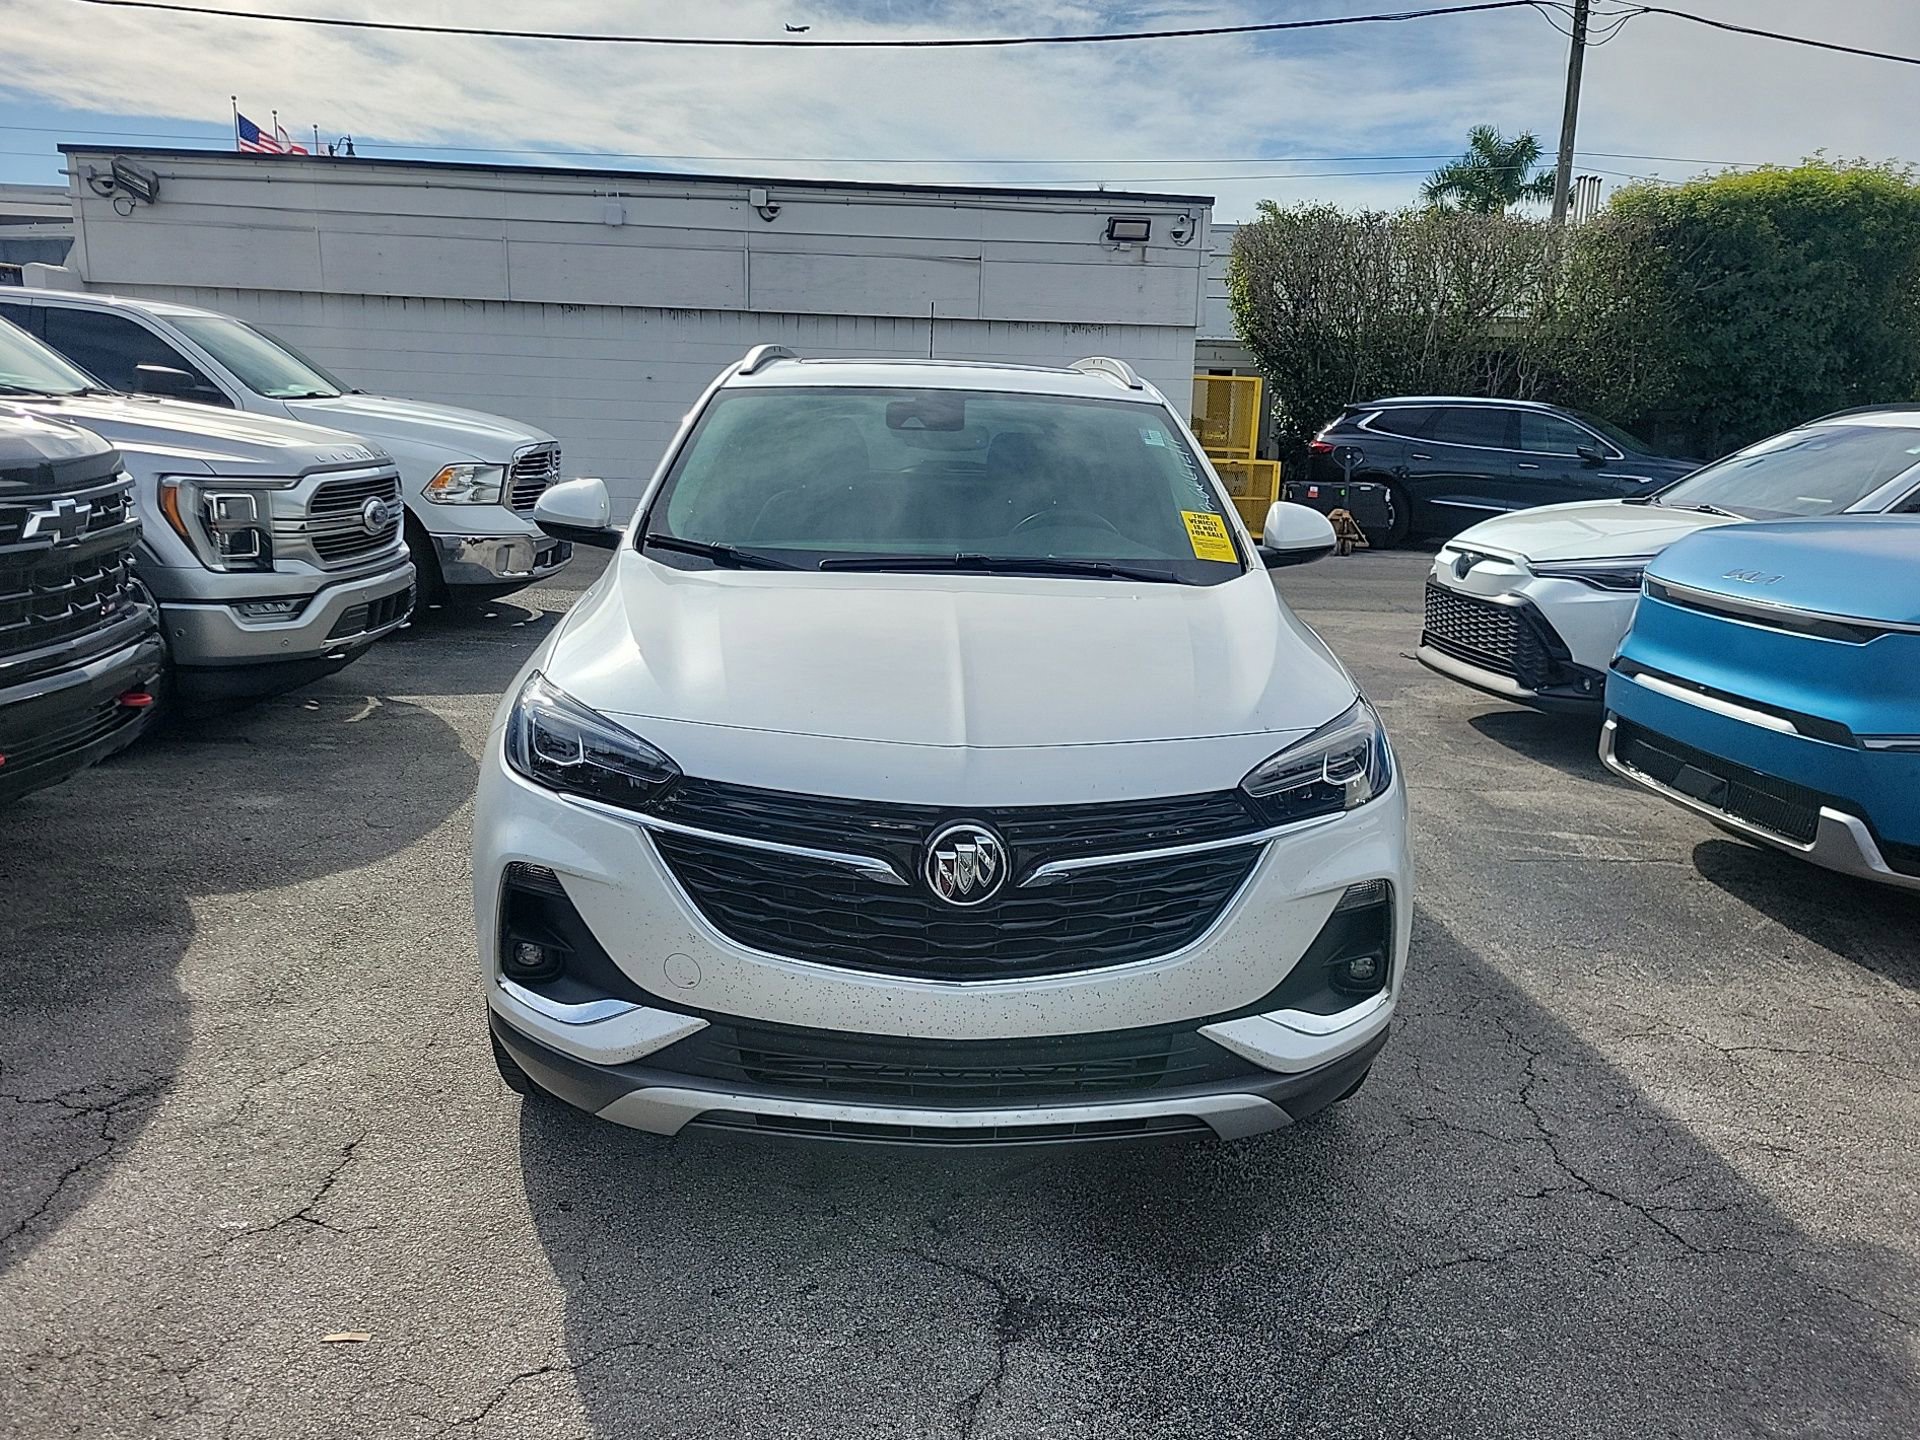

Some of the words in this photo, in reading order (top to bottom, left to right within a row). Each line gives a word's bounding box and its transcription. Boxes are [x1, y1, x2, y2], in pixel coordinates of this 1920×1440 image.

[1192, 513, 1211, 521] THIS
[1188, 518, 1219, 527] VEHICLE
[1191, 529, 1206, 537] FOR
[1207, 530, 1224, 539] SALE
